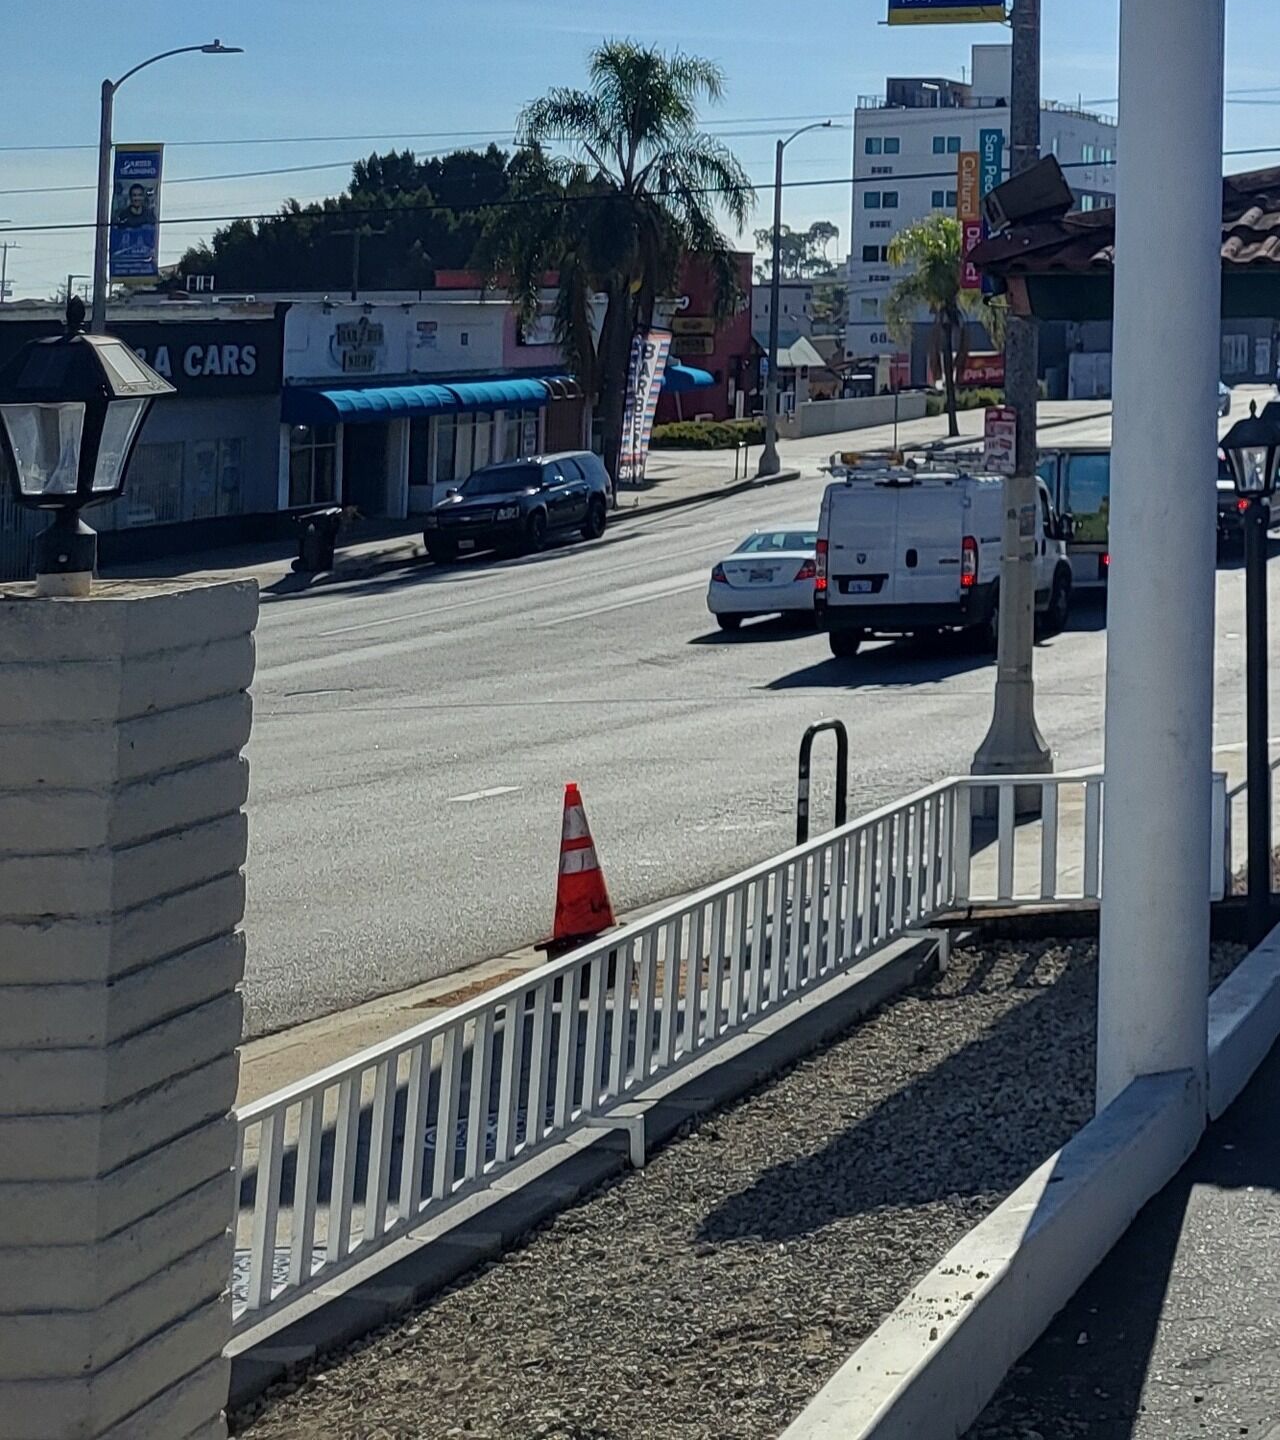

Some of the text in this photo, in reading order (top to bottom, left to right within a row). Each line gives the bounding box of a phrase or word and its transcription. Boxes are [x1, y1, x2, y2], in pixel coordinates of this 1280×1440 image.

[985, 134, 998, 162] San
[961, 156, 976, 219] Cultural
[153, 344, 258, 377] A CARS
[632, 342, 657, 450] BARBER
